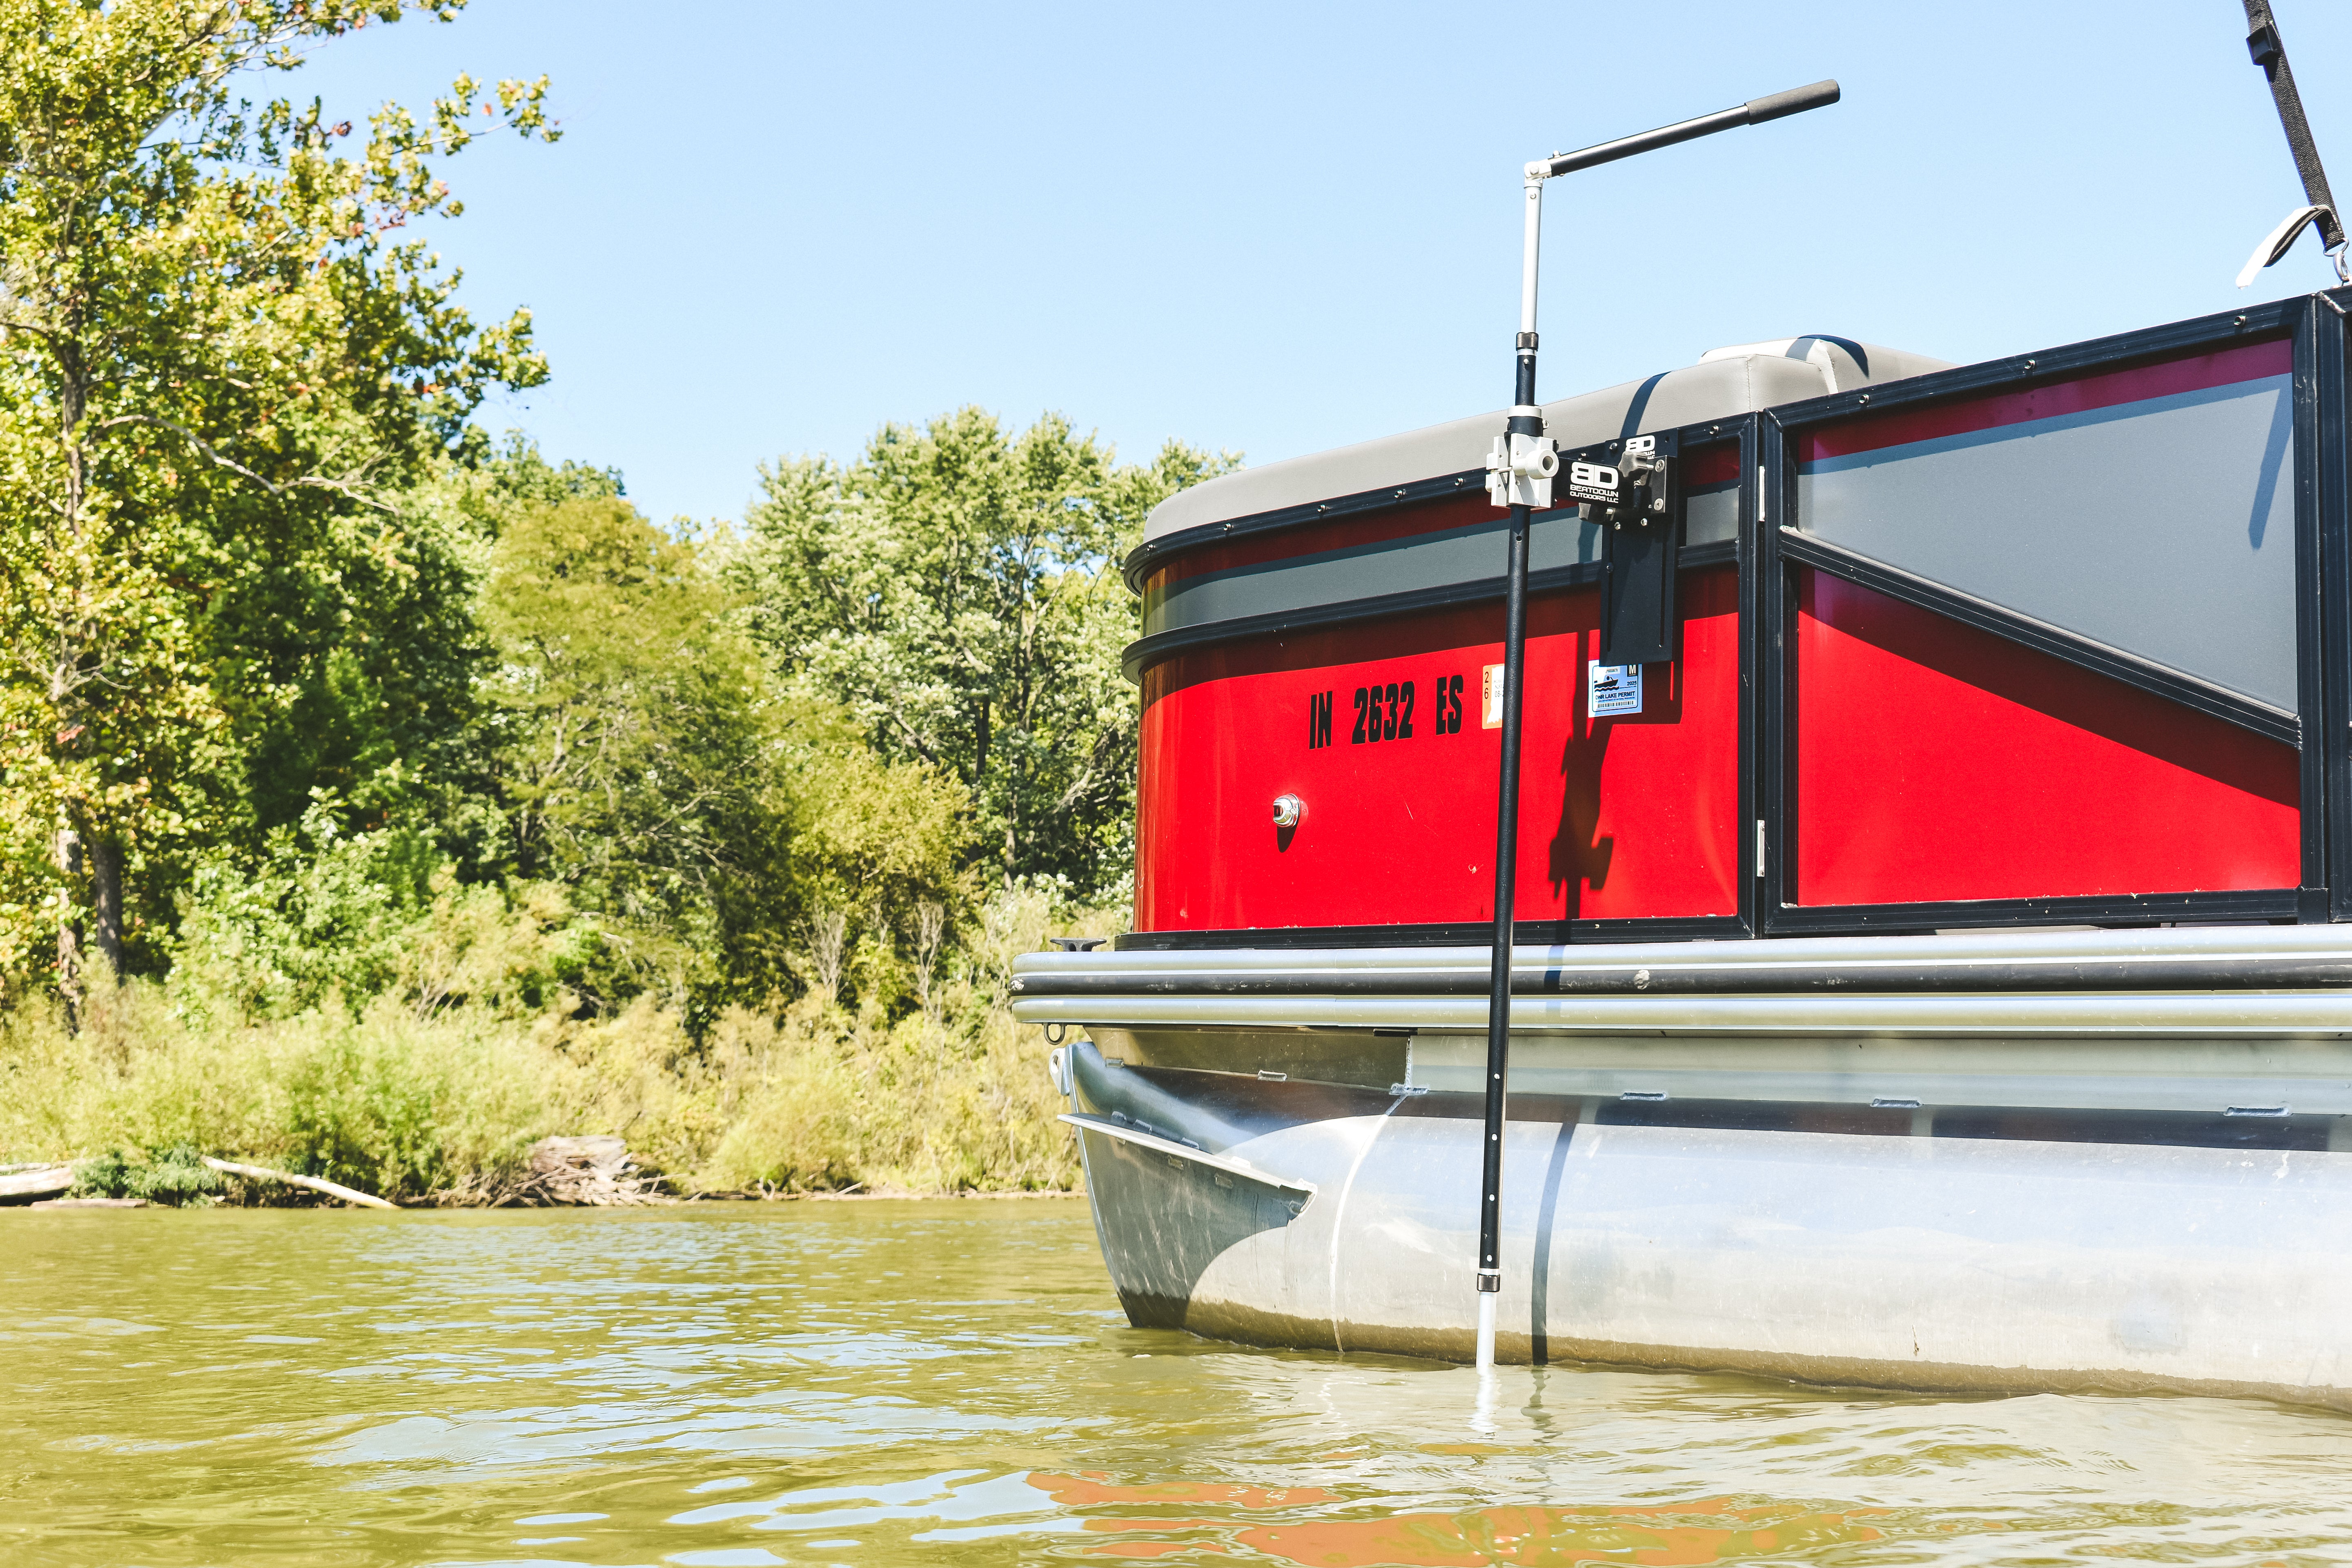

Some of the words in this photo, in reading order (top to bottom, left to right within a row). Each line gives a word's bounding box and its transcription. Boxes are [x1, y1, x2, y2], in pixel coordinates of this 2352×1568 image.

[1570, 484, 1619, 497] BEATDOWN
[1570, 491, 1606, 501] OUTDOORS
[1629, 664, 1636, 674] M
[1309, 691, 1332, 749] IN
[1352, 681, 1414, 744] 2632
[1436, 675, 1463, 735] ES
